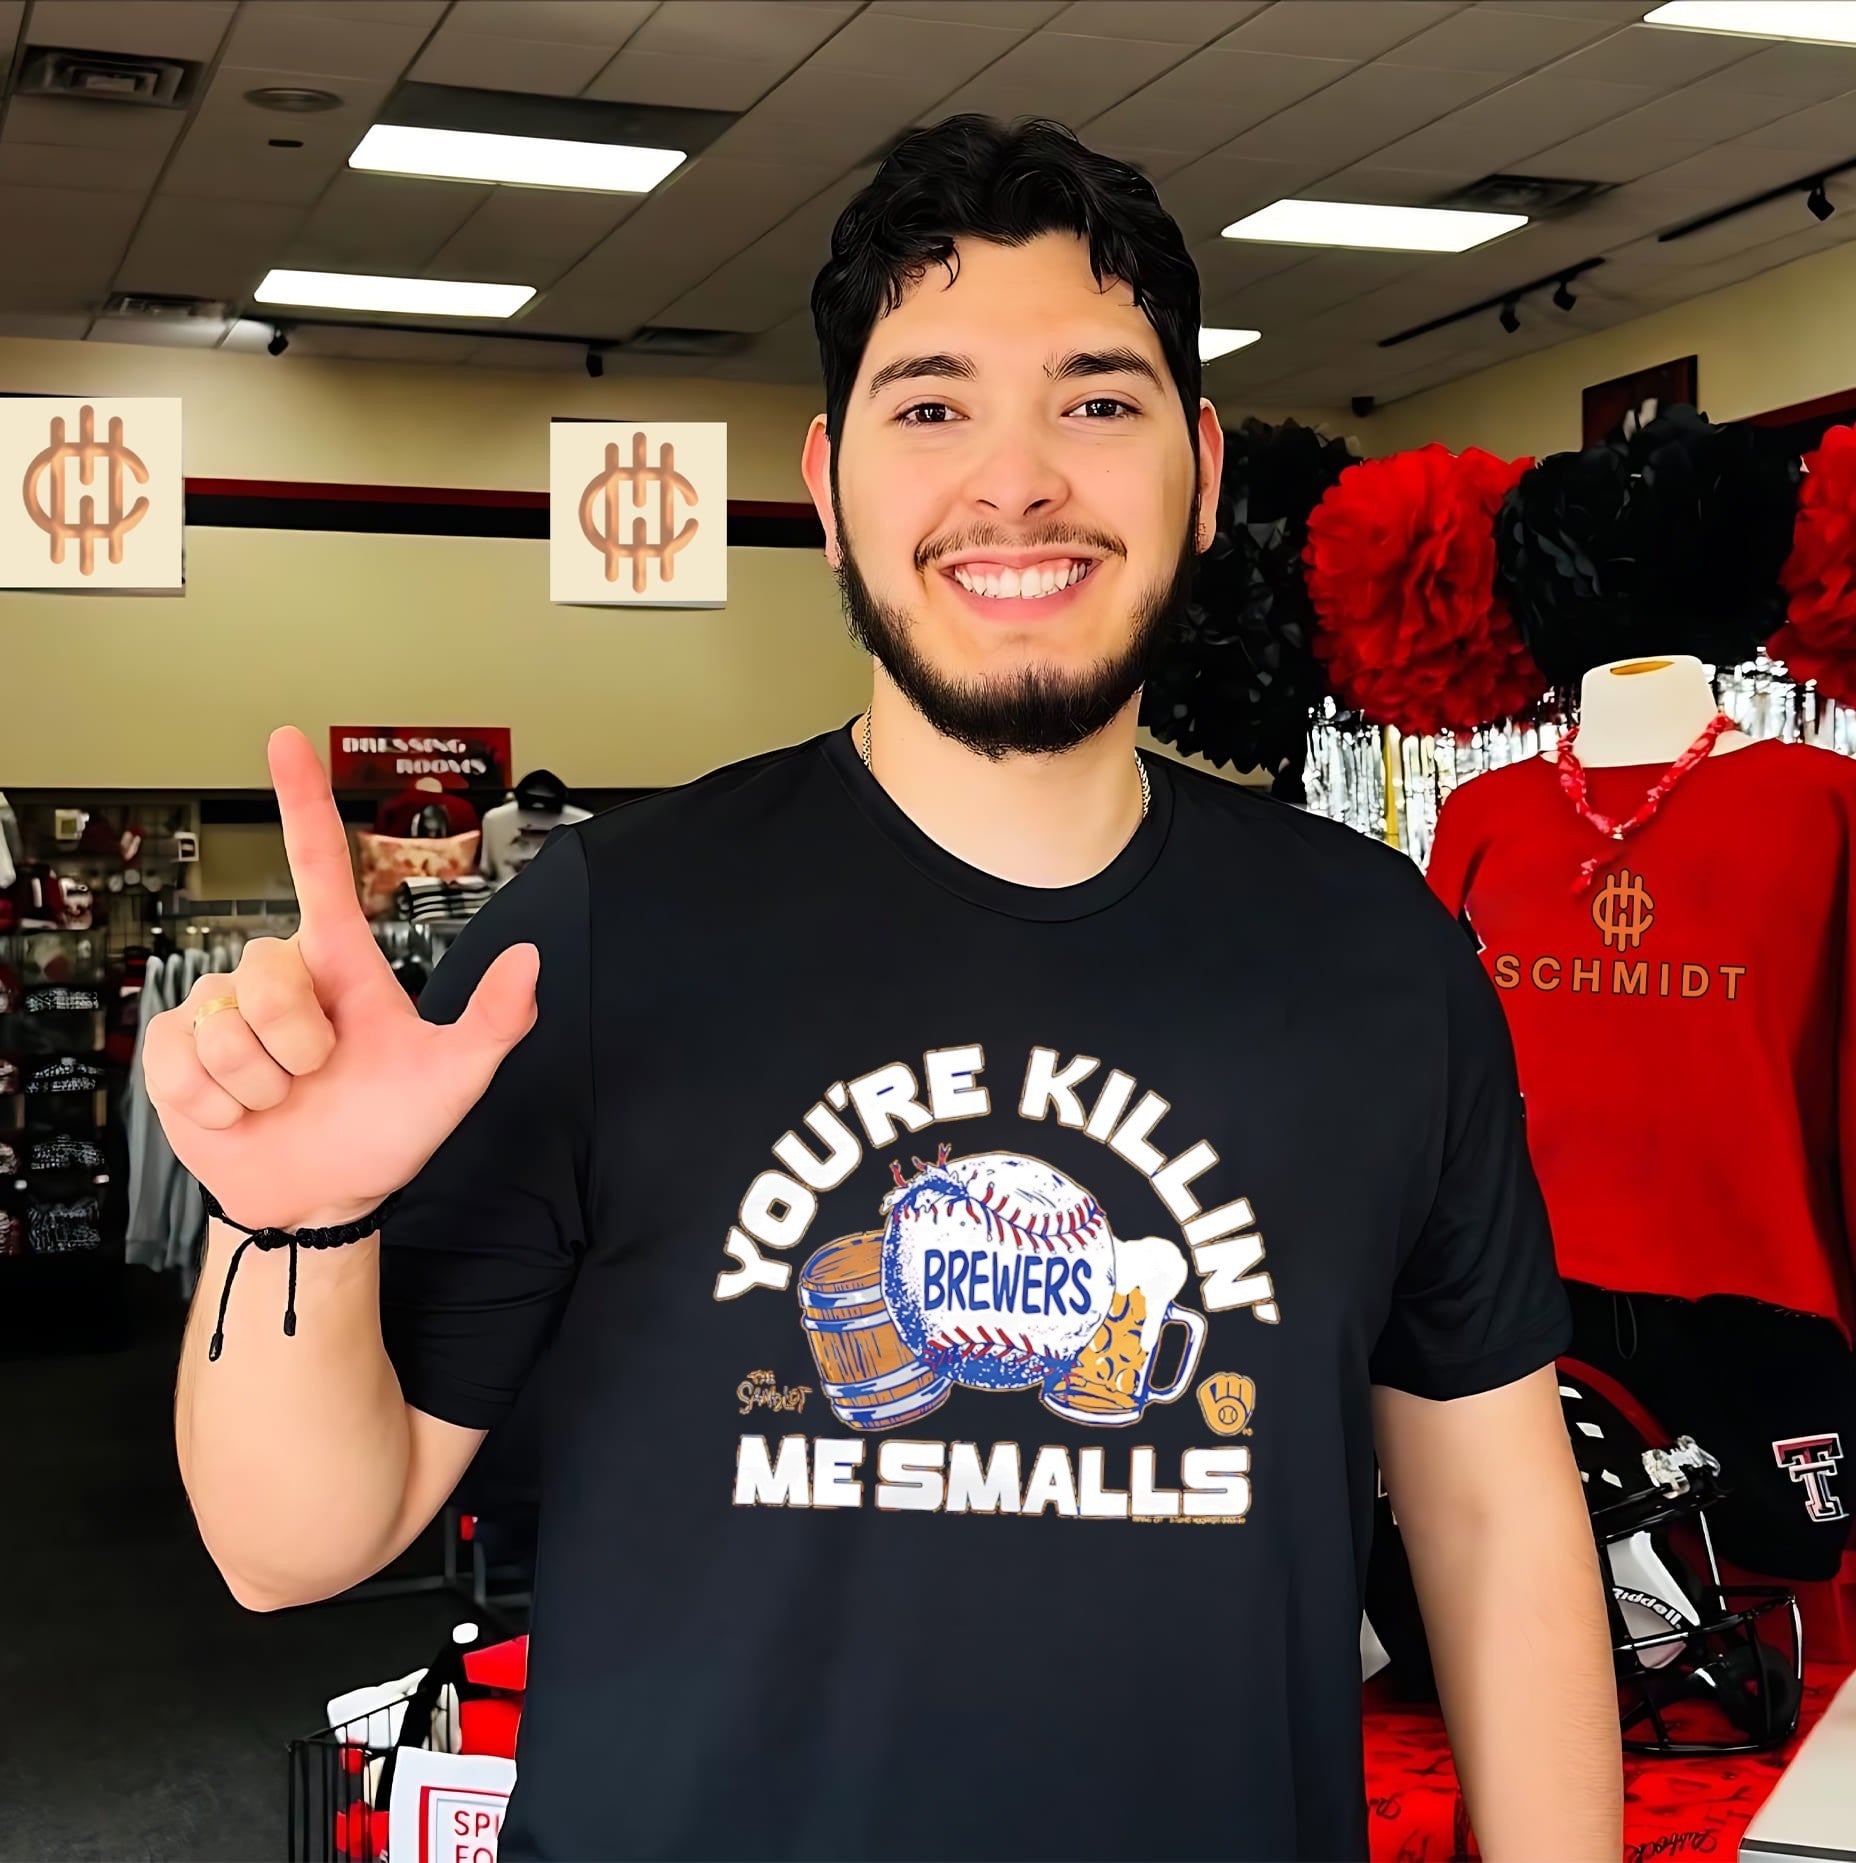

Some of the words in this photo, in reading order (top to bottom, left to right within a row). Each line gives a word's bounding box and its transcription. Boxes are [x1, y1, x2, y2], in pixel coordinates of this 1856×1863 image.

[342, 737, 467, 754] DRESSING
[396, 758, 487, 775] ROOMS
[1494, 954, 1746, 1000] SCHMIDT
[713, 1043, 991, 1301] YOU'RE
[1018, 1045, 1281, 1325] KILLIN'
[923, 1248, 1093, 1317] BREWERS
[732, 1434, 866, 1508] ME
[874, 1440, 1252, 1519] SMALLS
